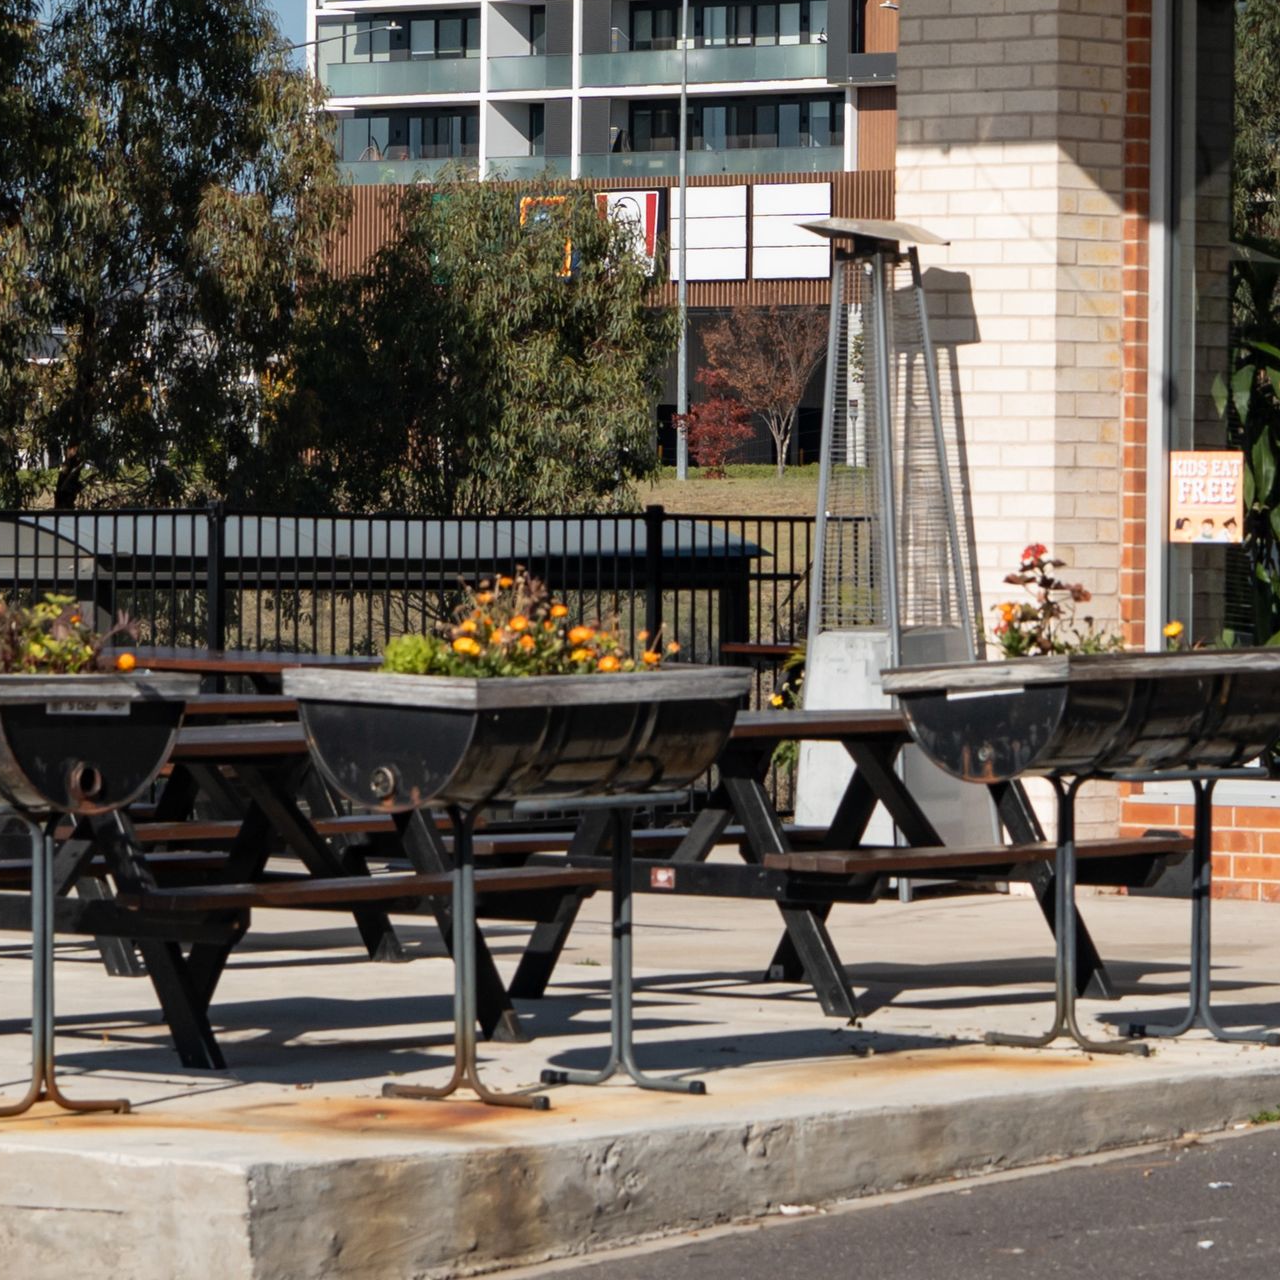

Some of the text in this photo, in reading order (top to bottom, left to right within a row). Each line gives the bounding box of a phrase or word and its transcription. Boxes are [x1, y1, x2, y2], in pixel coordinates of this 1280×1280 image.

[1173, 459, 1241, 477] KIDS EAT
[1178, 479, 1237, 504] FREE
